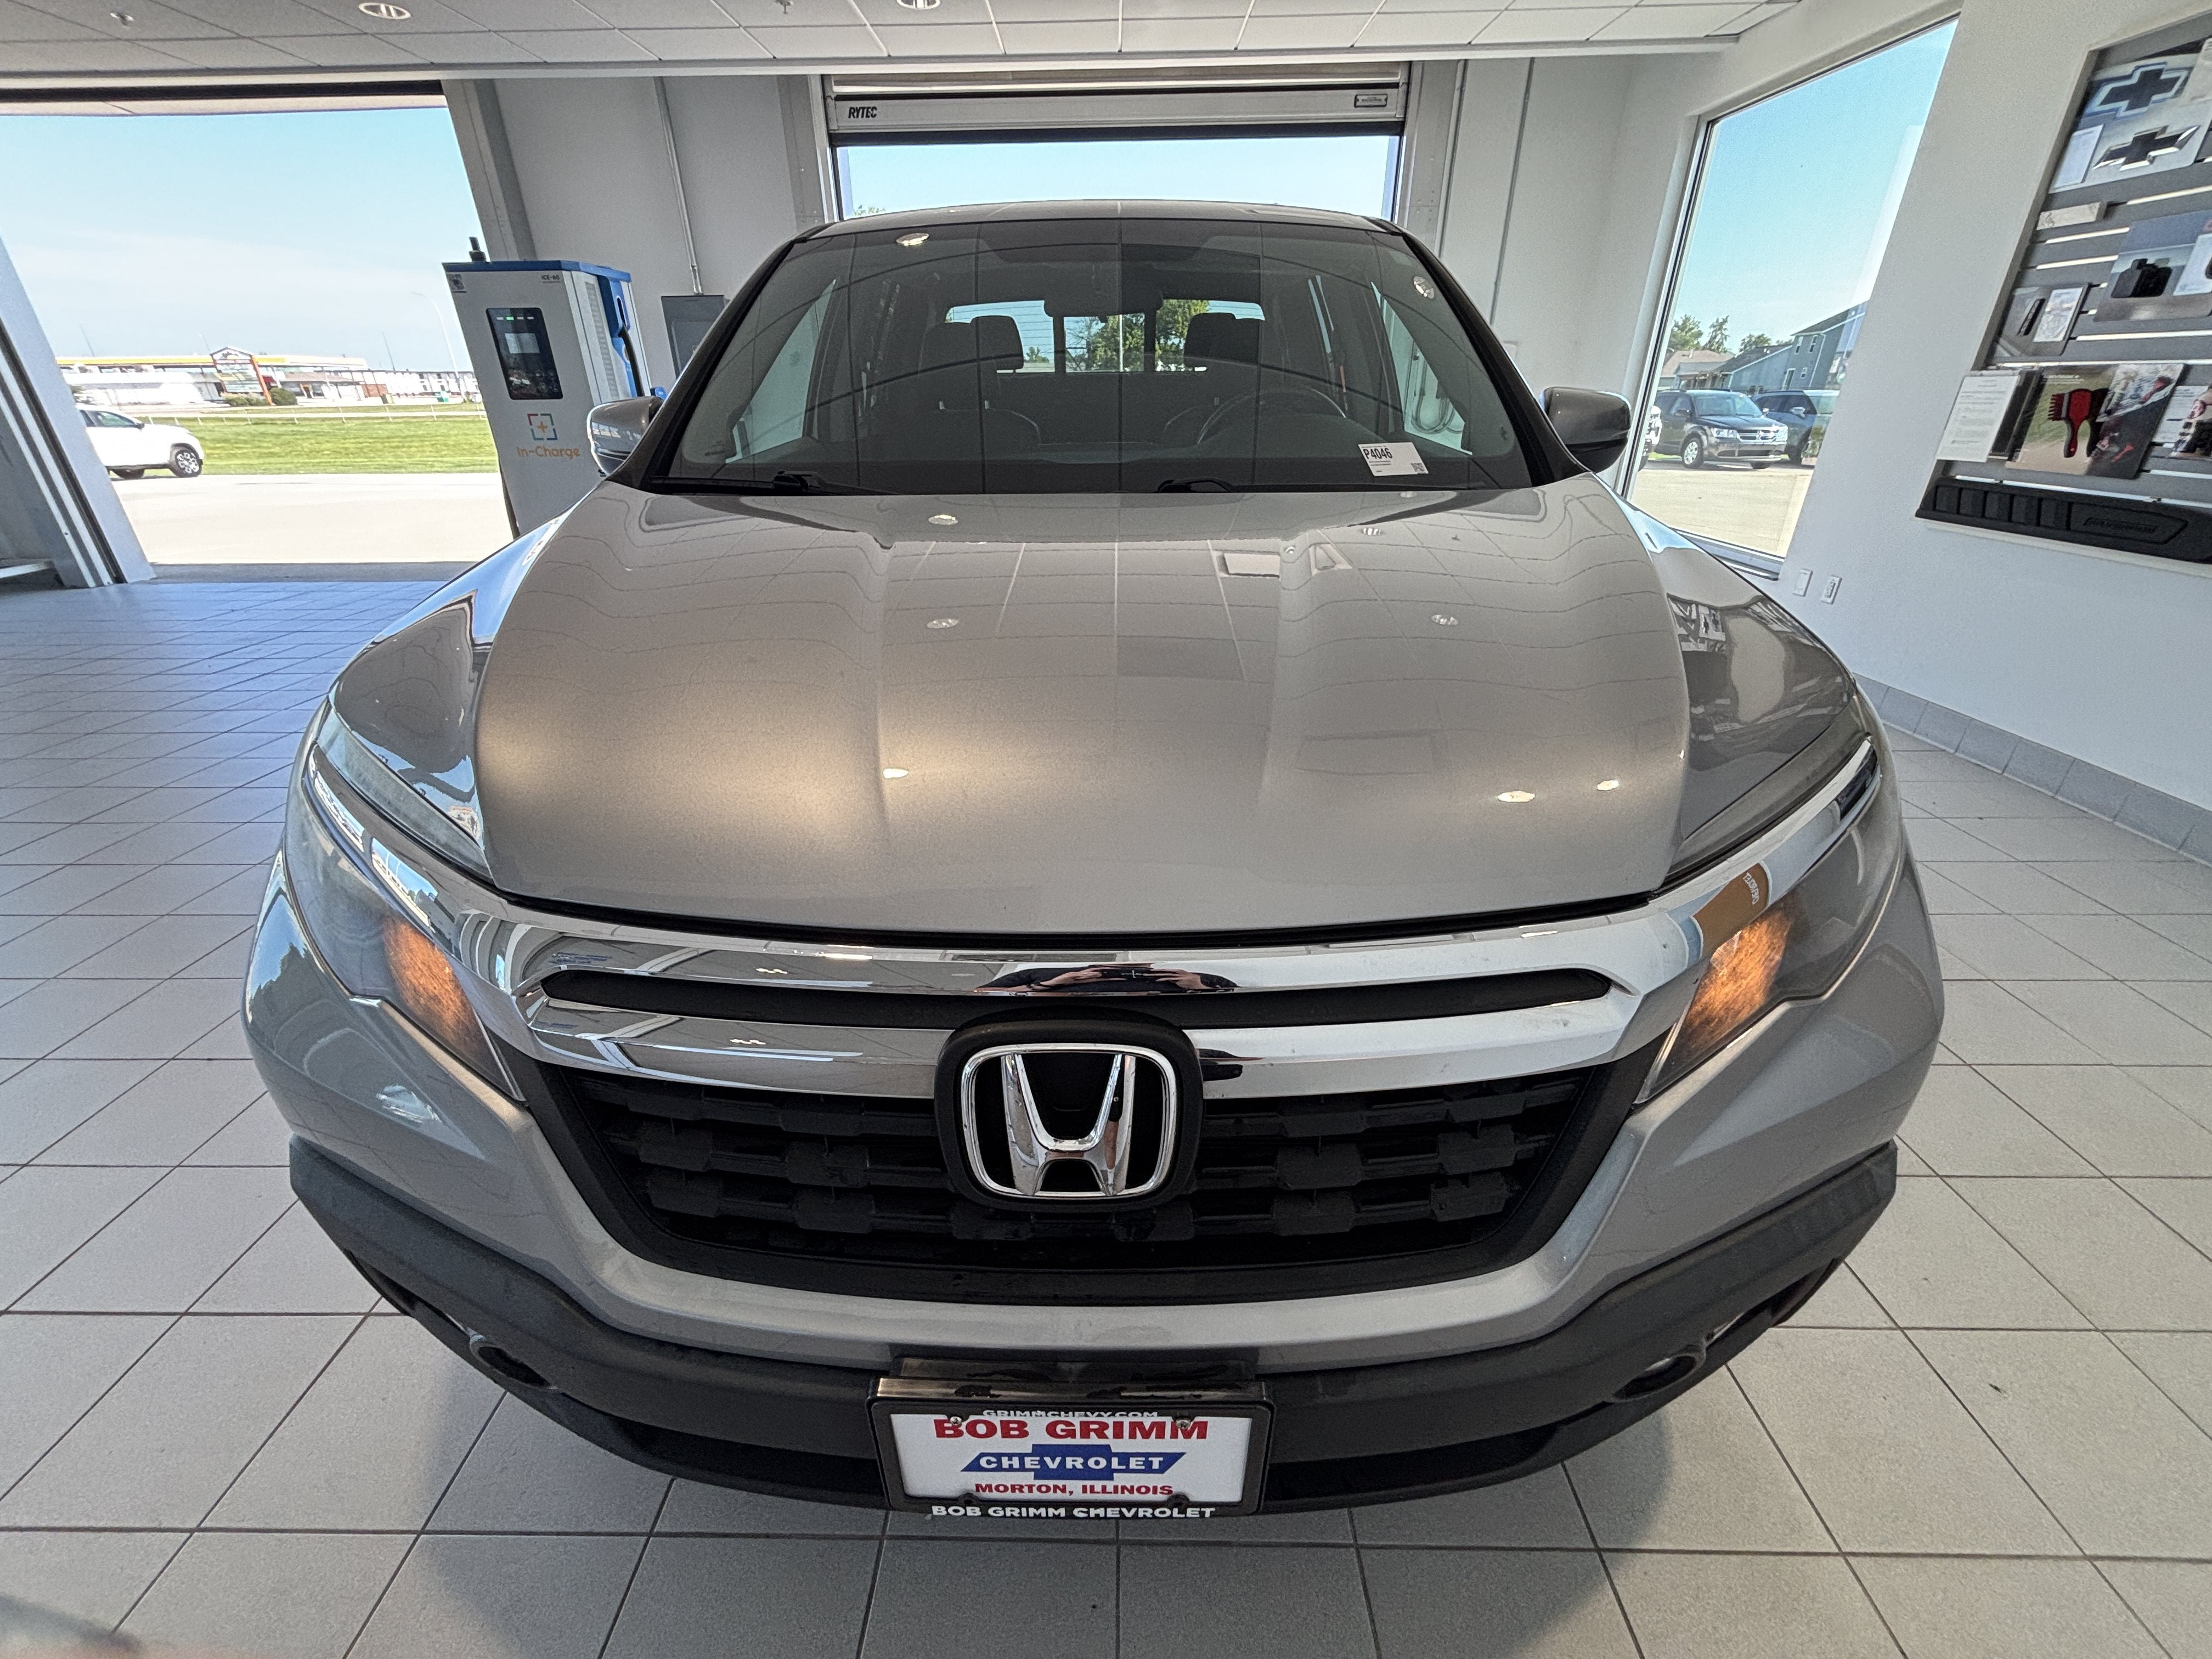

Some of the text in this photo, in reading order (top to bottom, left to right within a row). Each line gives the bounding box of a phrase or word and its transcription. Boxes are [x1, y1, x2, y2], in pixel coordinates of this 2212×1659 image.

[848, 106, 877, 119] RYTEC
[516, 445, 580, 460] In-Charge
[1363, 448, 1392, 459] P4046
[934, 1419, 1209, 1440] BOB GRIMM
[979, 1456, 1164, 1470] CHEVROLET
[975, 1483, 1173, 1496] MORTON, ILLINOIS
[932, 1506, 1216, 1518] BOB GRIMM CHEVROLET
